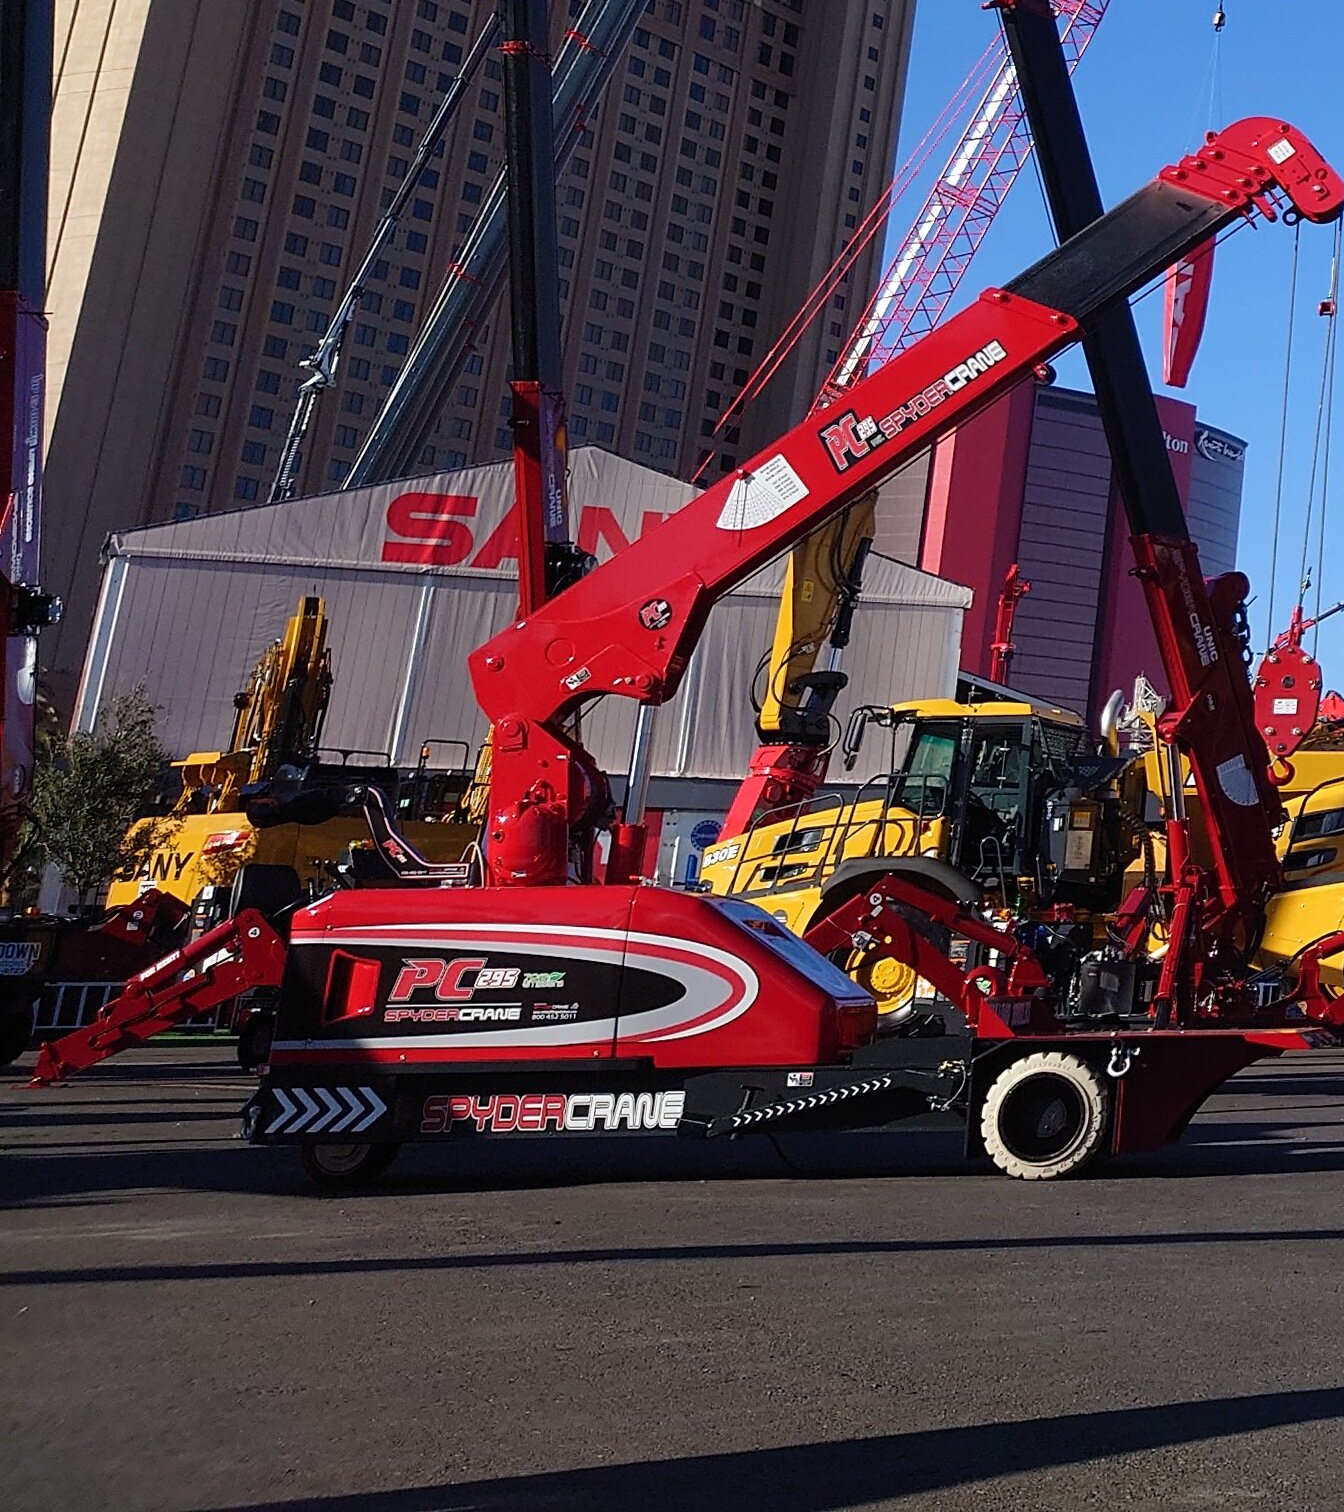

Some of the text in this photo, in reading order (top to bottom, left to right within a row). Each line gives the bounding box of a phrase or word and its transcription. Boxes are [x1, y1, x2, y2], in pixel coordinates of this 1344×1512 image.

[822, 340, 1007, 470] PC 295 SPYDERCRANE
[1162, 430, 1189, 454] ton
[382, 492, 682, 570] SAN
[1203, 626, 1219, 662] UNIC
[388, 957, 521, 1001] PC 295
[384, 1007, 523, 1023] SPYDERCRANE
[420, 1090, 686, 1133] SPYDERCRANE
